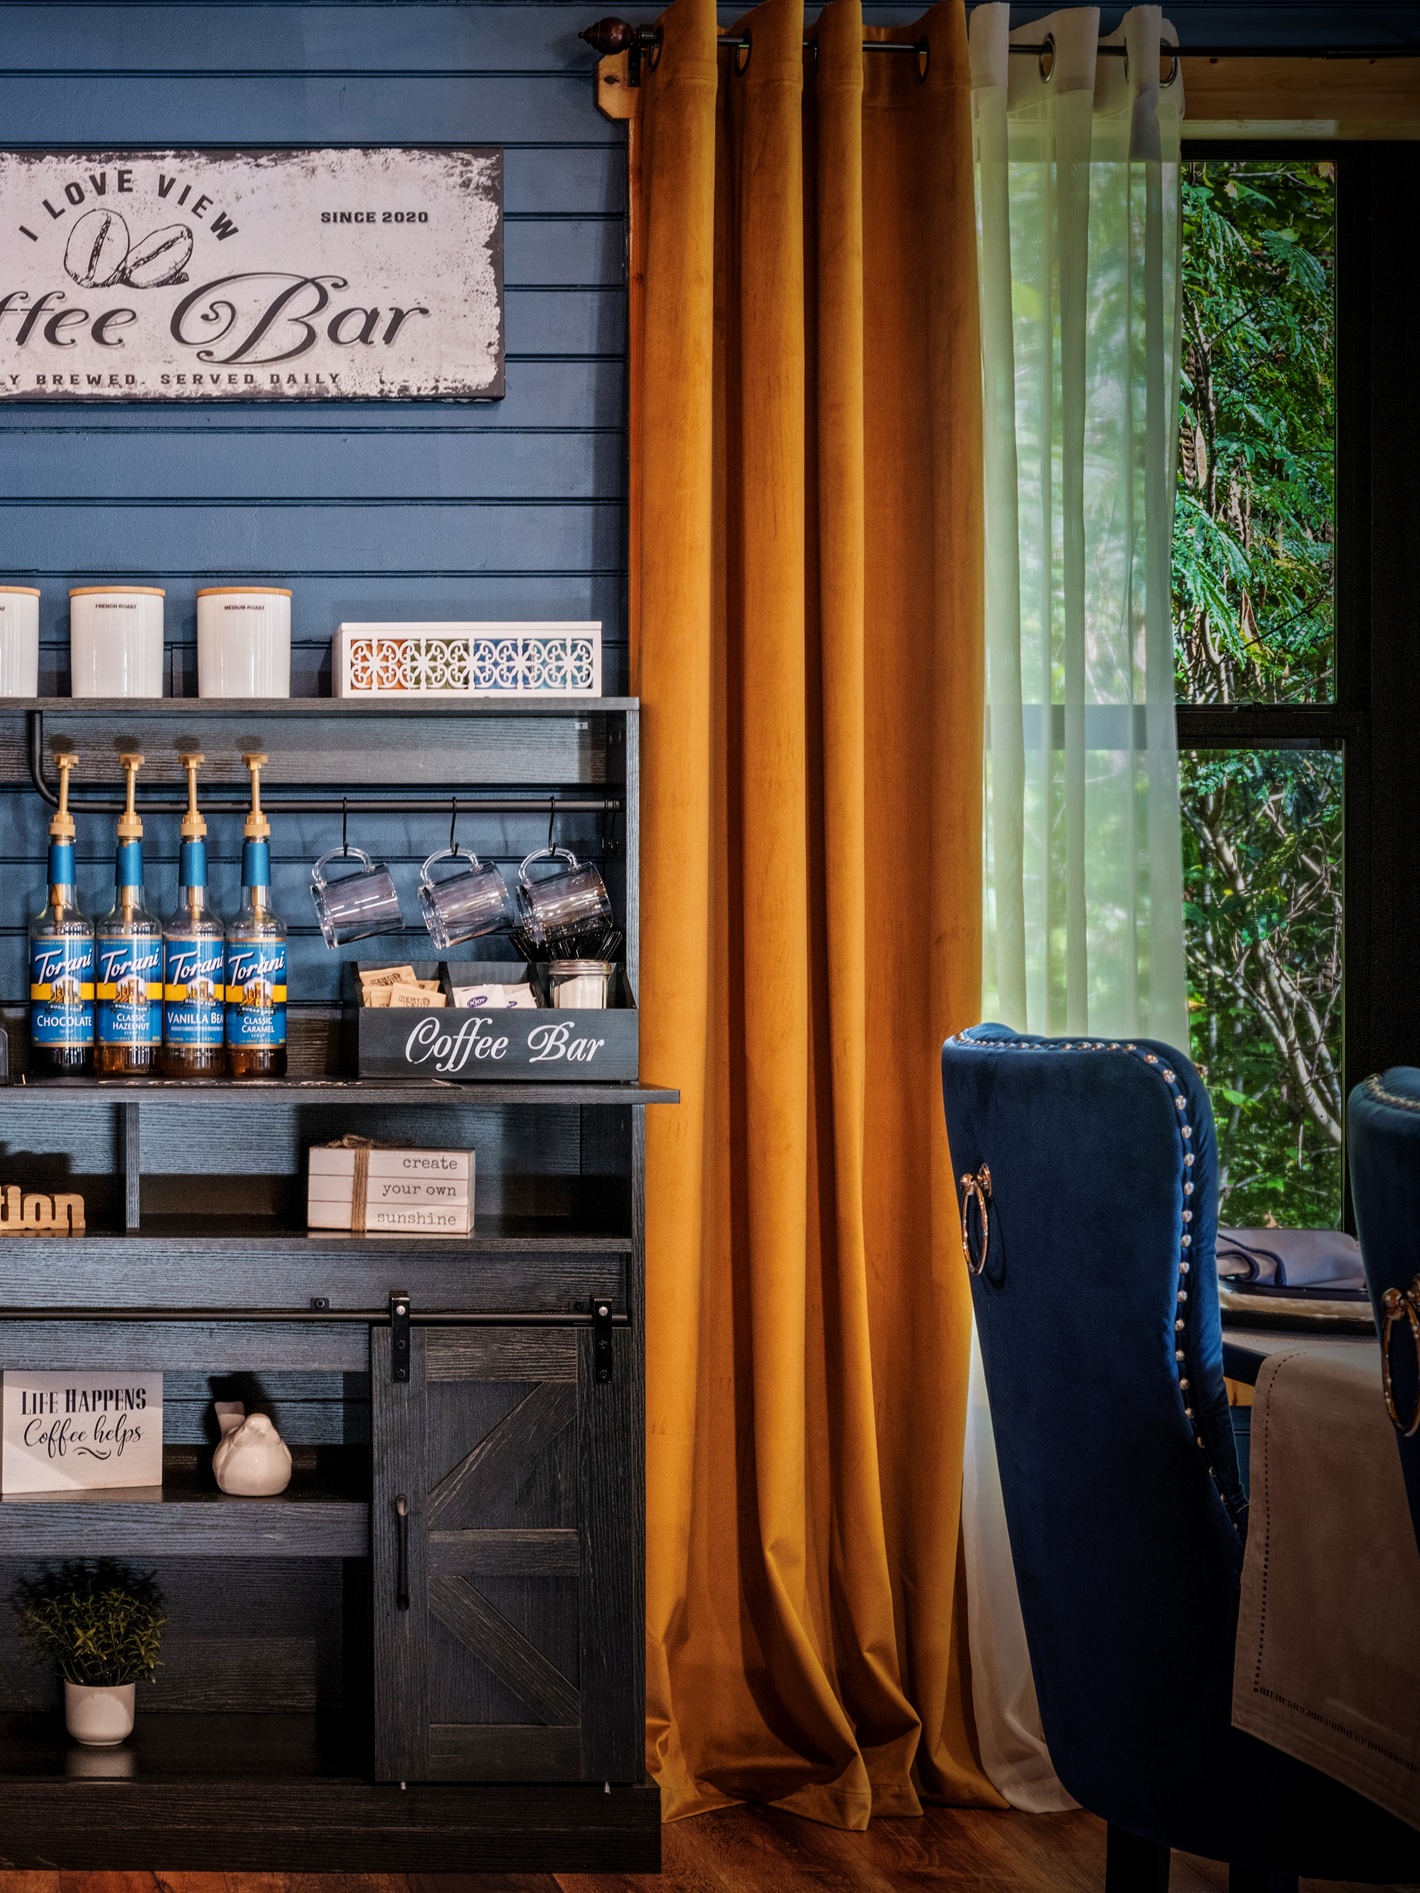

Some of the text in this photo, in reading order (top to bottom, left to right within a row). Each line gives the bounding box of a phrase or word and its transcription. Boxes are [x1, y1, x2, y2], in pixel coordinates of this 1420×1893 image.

[18, 169, 239, 242] I LOVE VIEW
[320, 211, 429, 224] SINCE 2020
[170, 271, 430, 365] Bar
[160, 373, 255, 385] SERVED
[270, 373, 340, 385] DAILY
[34, 948, 93, 987] Torani
[100, 947, 160, 986] Torani
[169, 950, 225, 987] Torani
[228, 950, 285, 988] Torani
[36, 1015, 92, 1027] CHOCOLATE
[116, 1013, 146, 1022] CLASSIC
[167, 1011, 225, 1025] VANILLA BEA
[243, 1016, 273, 1025] CLASSIC
[112, 1021, 150, 1031] HAZELNUT
[241, 1024, 275, 1034] CARAMEL
[405, 1016, 605, 1072] Coffee Bar
[402, 1156, 458, 1171] create
[382, 1183, 457, 1197] your own
[377, 1212, 457, 1227] sunshine
[21, 1387, 147, 1416] LIFE HAPPENS
[23, 1413, 146, 1459] Coffee helps
